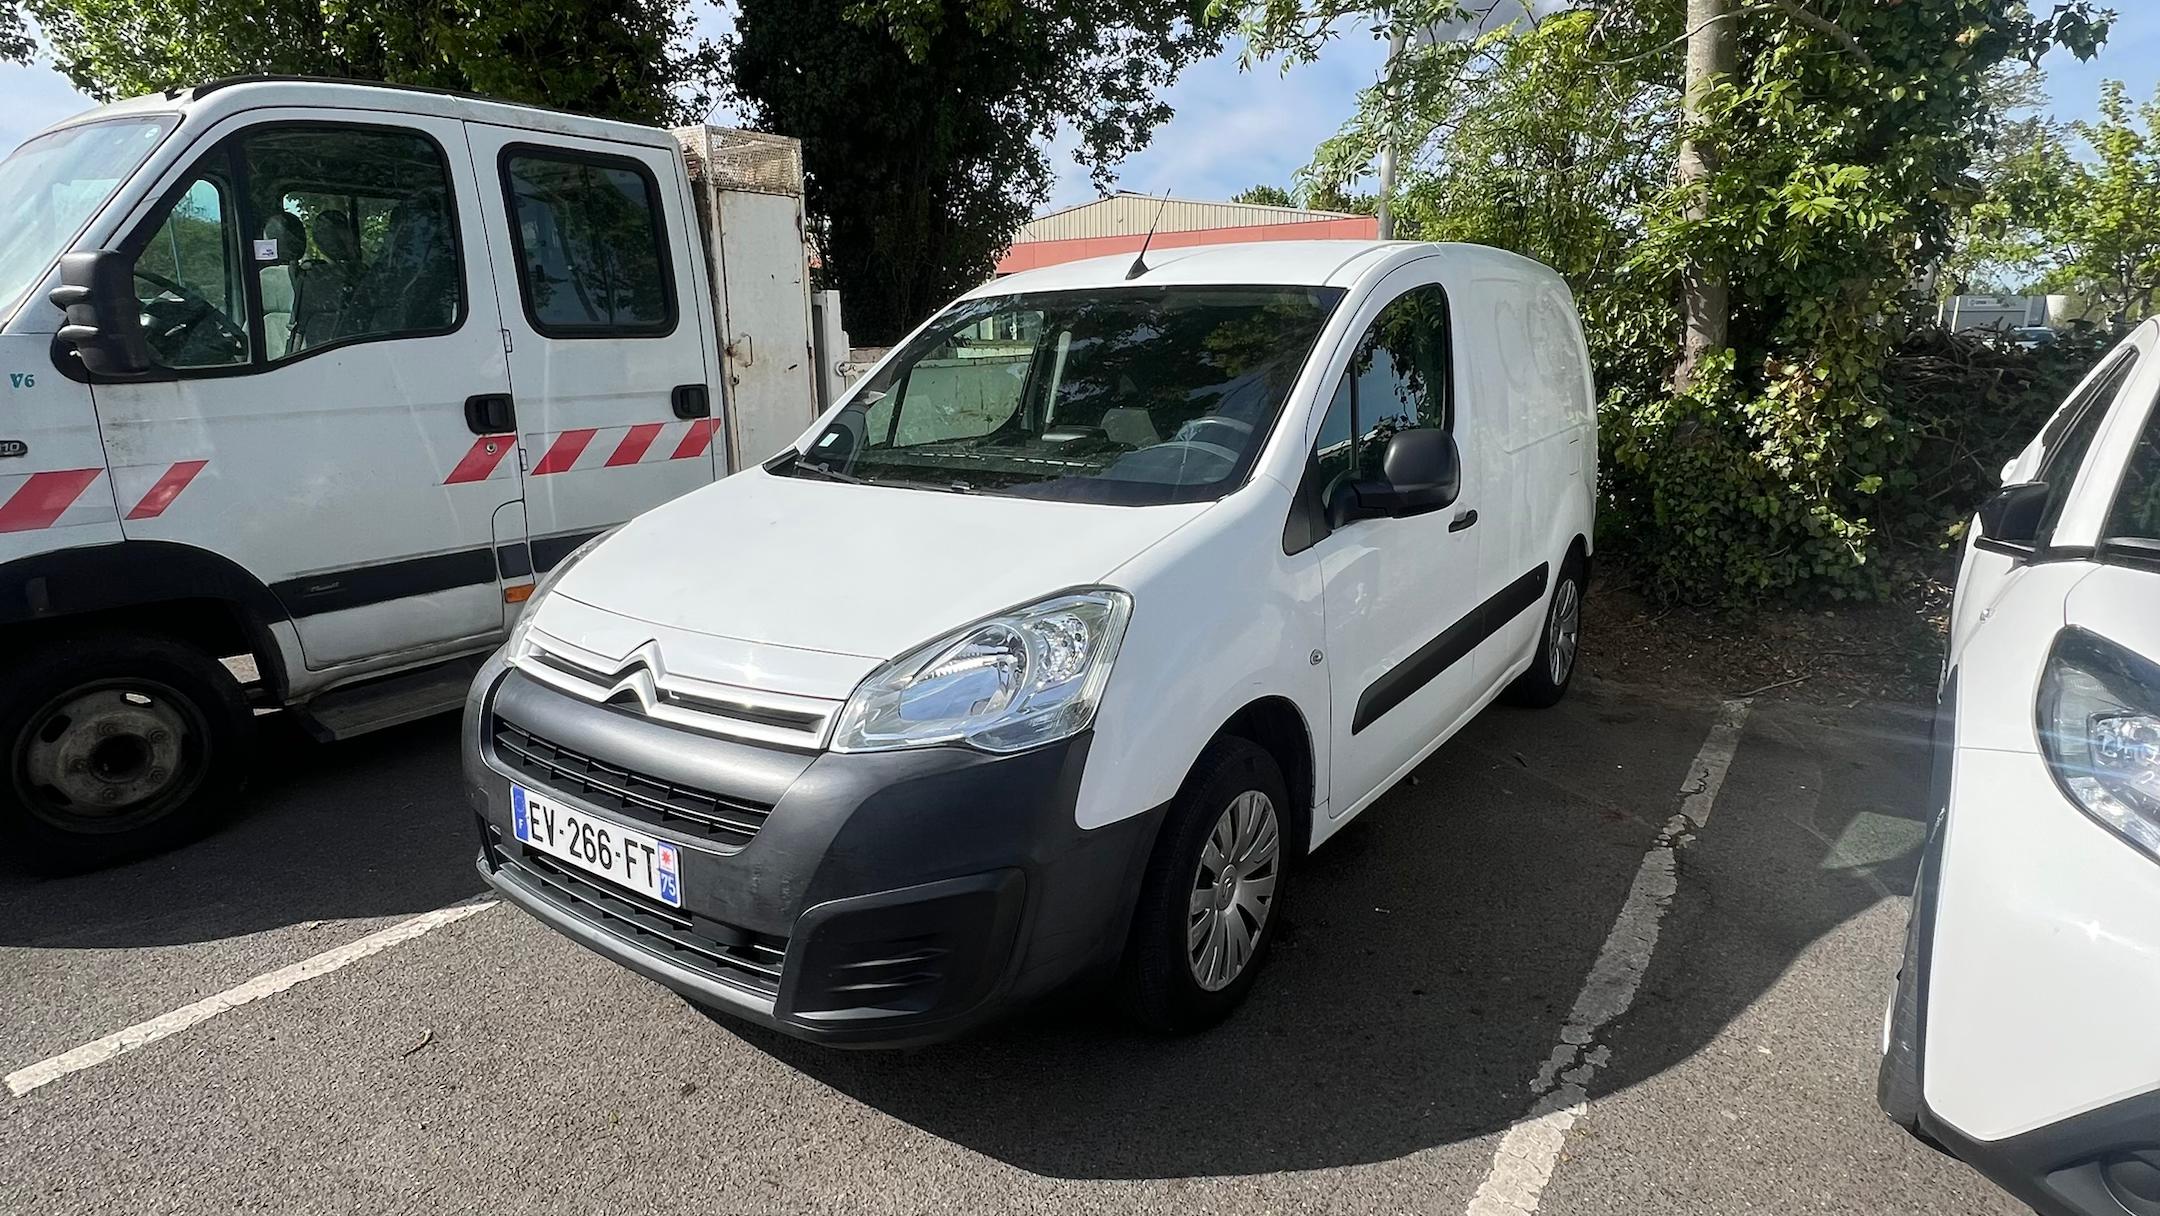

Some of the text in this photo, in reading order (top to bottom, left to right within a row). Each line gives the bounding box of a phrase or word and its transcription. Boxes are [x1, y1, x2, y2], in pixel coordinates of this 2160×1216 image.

[10, 373, 35, 388] V6
[518, 818, 524, 829] F
[529, 800, 655, 888] EV-266-FT
[661, 873, 676, 896] 75
